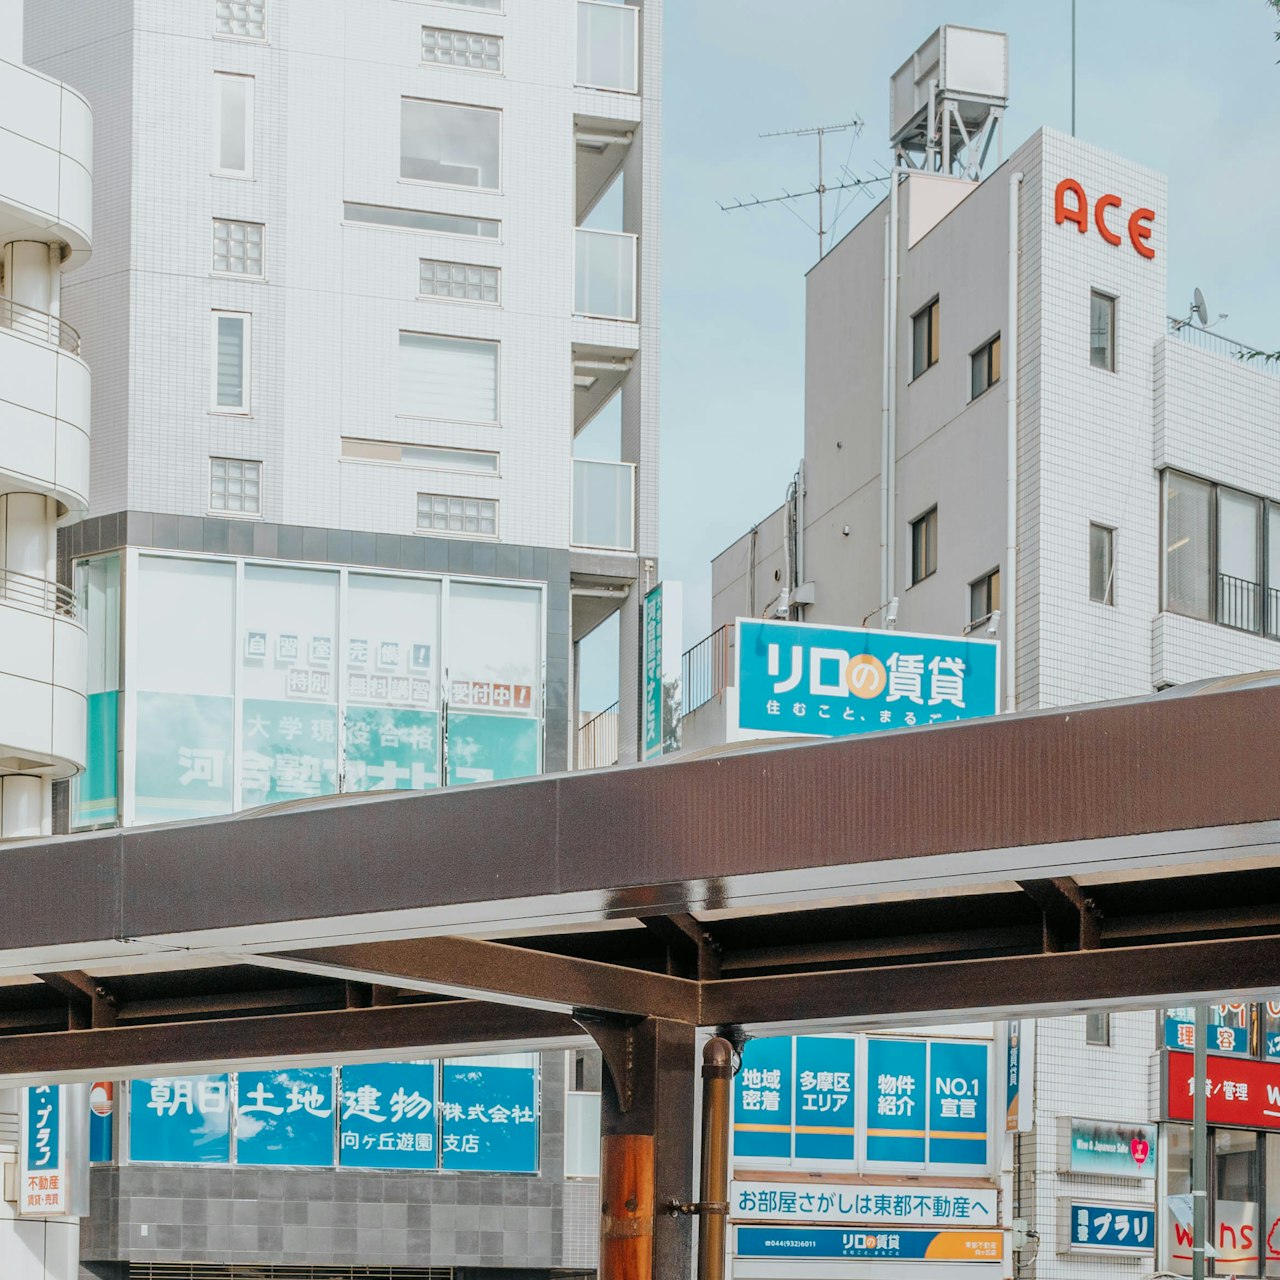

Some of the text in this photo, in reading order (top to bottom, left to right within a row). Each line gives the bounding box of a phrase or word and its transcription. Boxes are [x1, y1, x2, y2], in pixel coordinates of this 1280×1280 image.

[1055, 178, 1155, 259] ACE
[768, 643, 966, 708] リロの賃貸
[766, 699, 961, 726] 住むこと、まる
[741, 1069, 781, 1089] 地域
[800, 1071, 851, 1093] 多摩区
[878, 1074, 915, 1095] 物件
[936, 1077, 979, 1097] NO.1
[147, 1080, 535, 1125] 朝日土地建物 株式会社
[741, 1090, 781, 1111] 密着
[802, 1094, 848, 1113] エリア
[877, 1095, 915, 1117] 紹介
[940, 1098, 977, 1119] 宣言
[28, 1175, 59, 1191] 不動産
[738, 1189, 989, 1218] お部屋さがしは東都不動産へ
[1093, 1211, 1149, 1243] プラリ
[1174, 1222, 1255, 1251] wns
[842, 1233, 901, 1250] リロの賃貸
